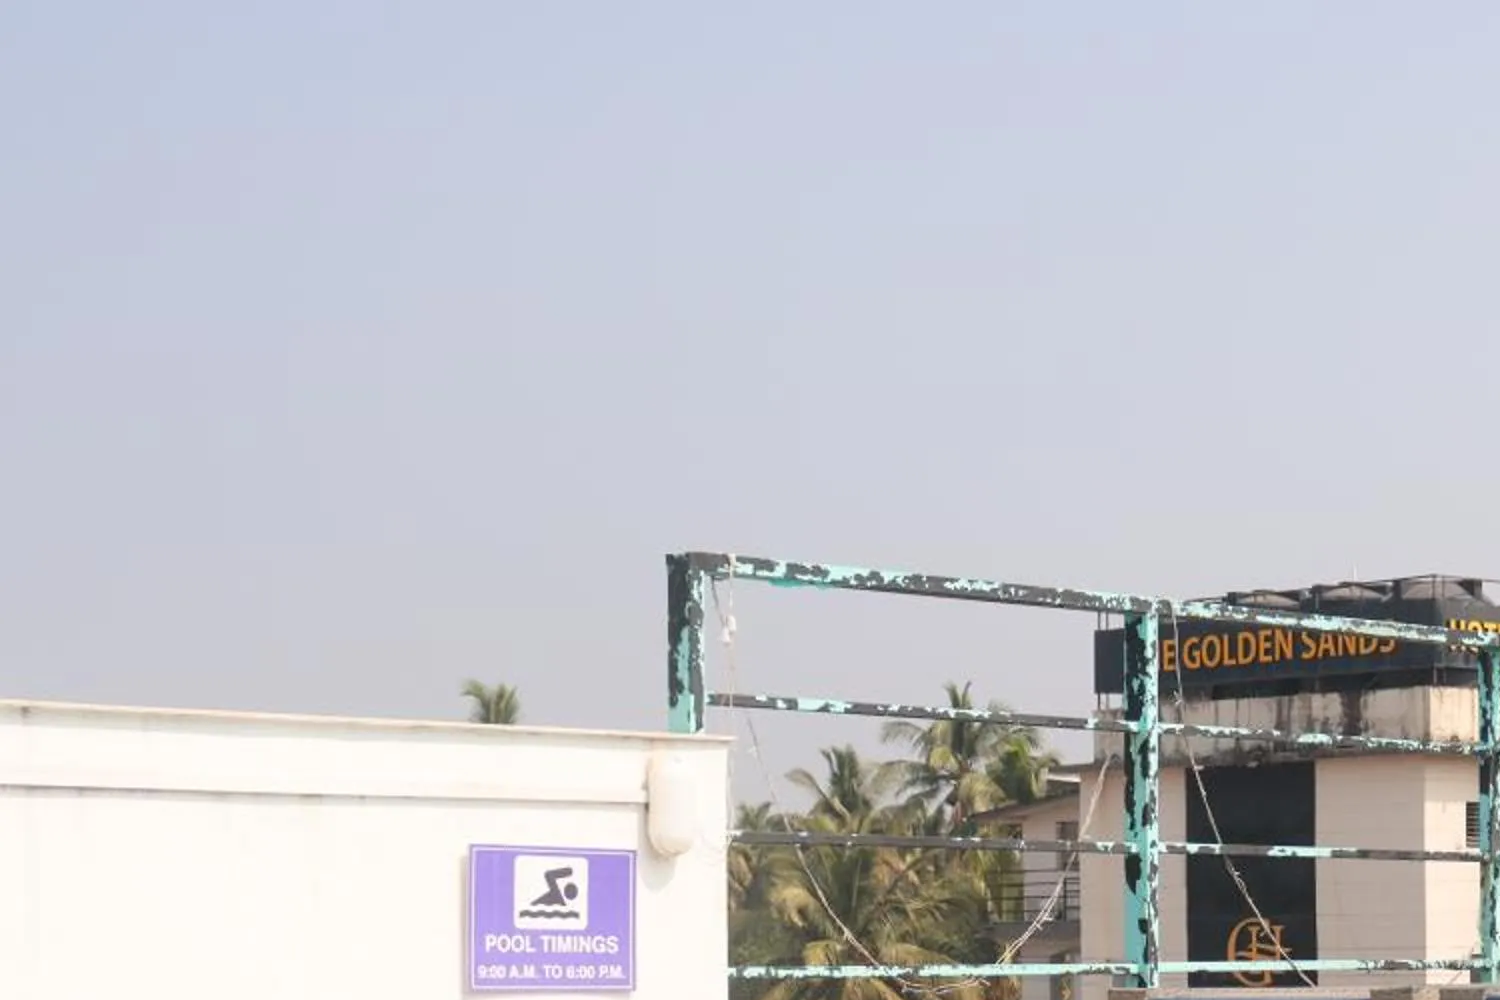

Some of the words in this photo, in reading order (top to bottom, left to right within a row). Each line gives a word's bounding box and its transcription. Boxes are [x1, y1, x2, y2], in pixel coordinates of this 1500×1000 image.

[1182, 628, 1293, 670] GOLDEN
[485, 934, 536, 953] POOL
[541, 935, 619, 954] TIMINGS
[543, 965, 563, 979] TO
